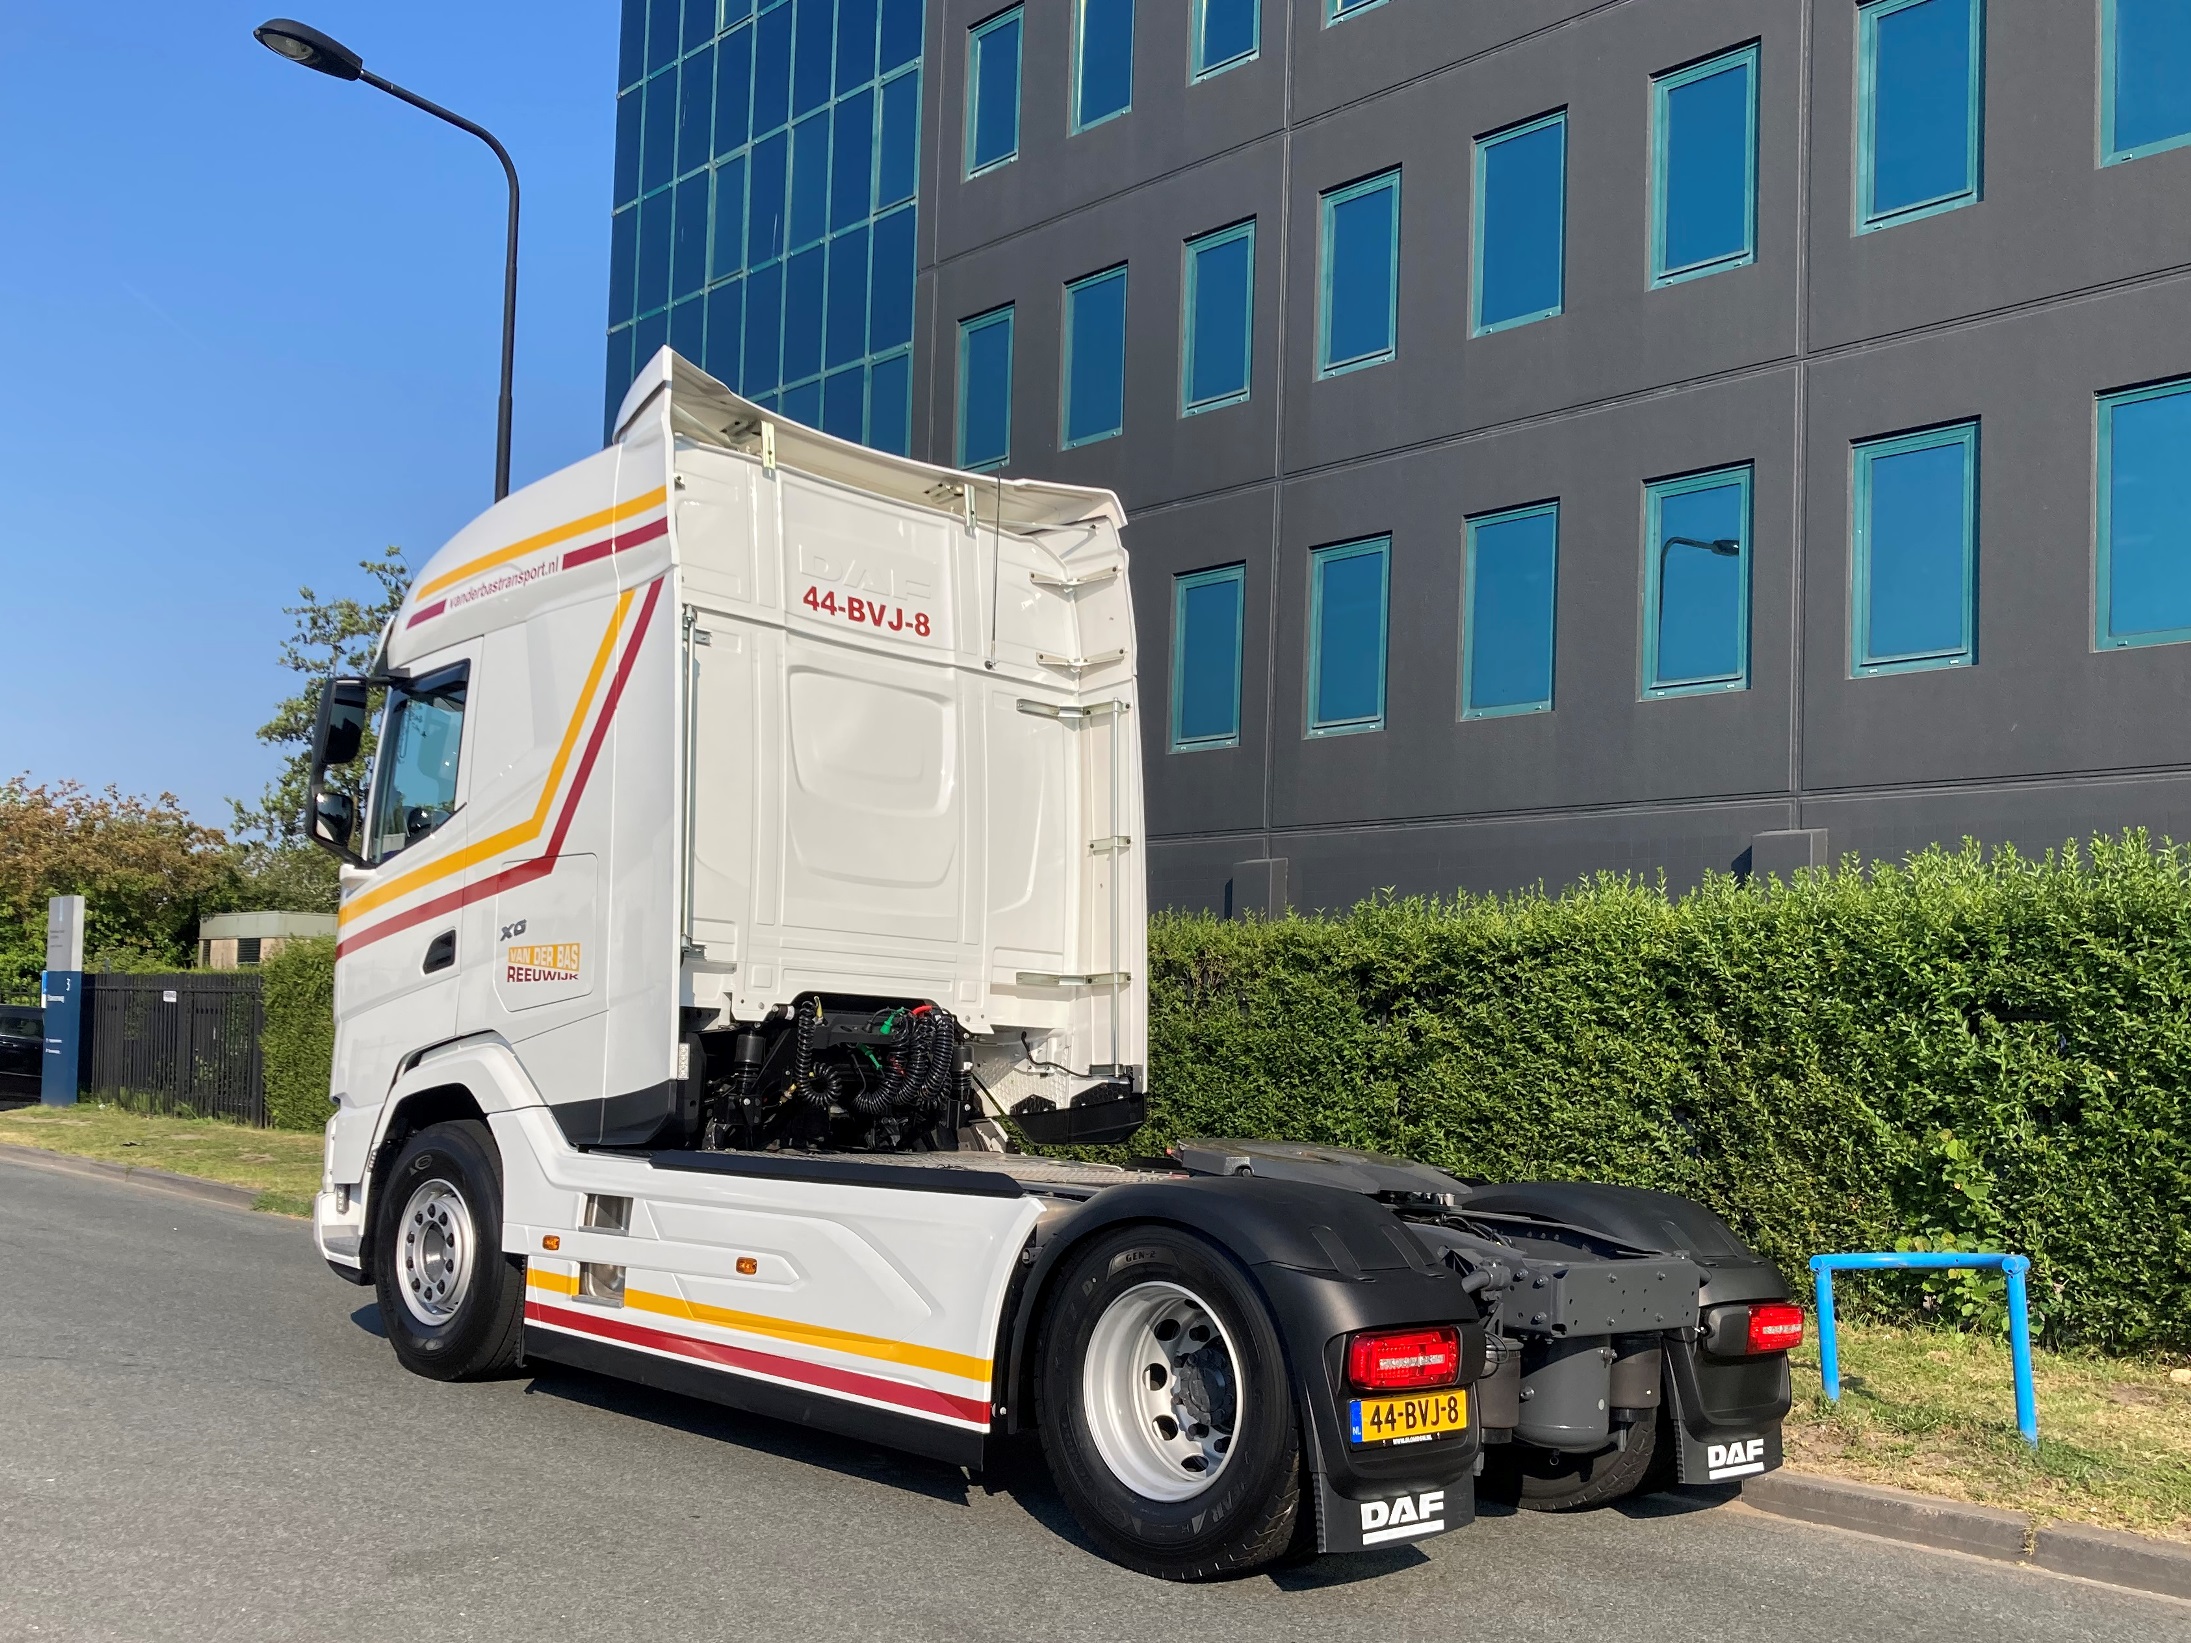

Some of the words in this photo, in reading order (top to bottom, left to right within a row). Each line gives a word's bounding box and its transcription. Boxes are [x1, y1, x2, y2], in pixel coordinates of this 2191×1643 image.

[449, 555, 559, 608] vanderbastransport.nl
[803, 586, 931, 637] 44-BVJ-8
[500, 919, 527, 941] XG
[509, 947, 531, 964] VAN
[533, 946, 554, 967] DER
[556, 944, 579, 969] BAS
[507, 966, 579, 982] REEUWIJK
[1370, 1396, 1459, 1434] 44-BVJ-8
[1352, 1426, 1361, 1435] NL
[1708, 1438, 1764, 1468] DAF
[1361, 1490, 1444, 1530] DAF
